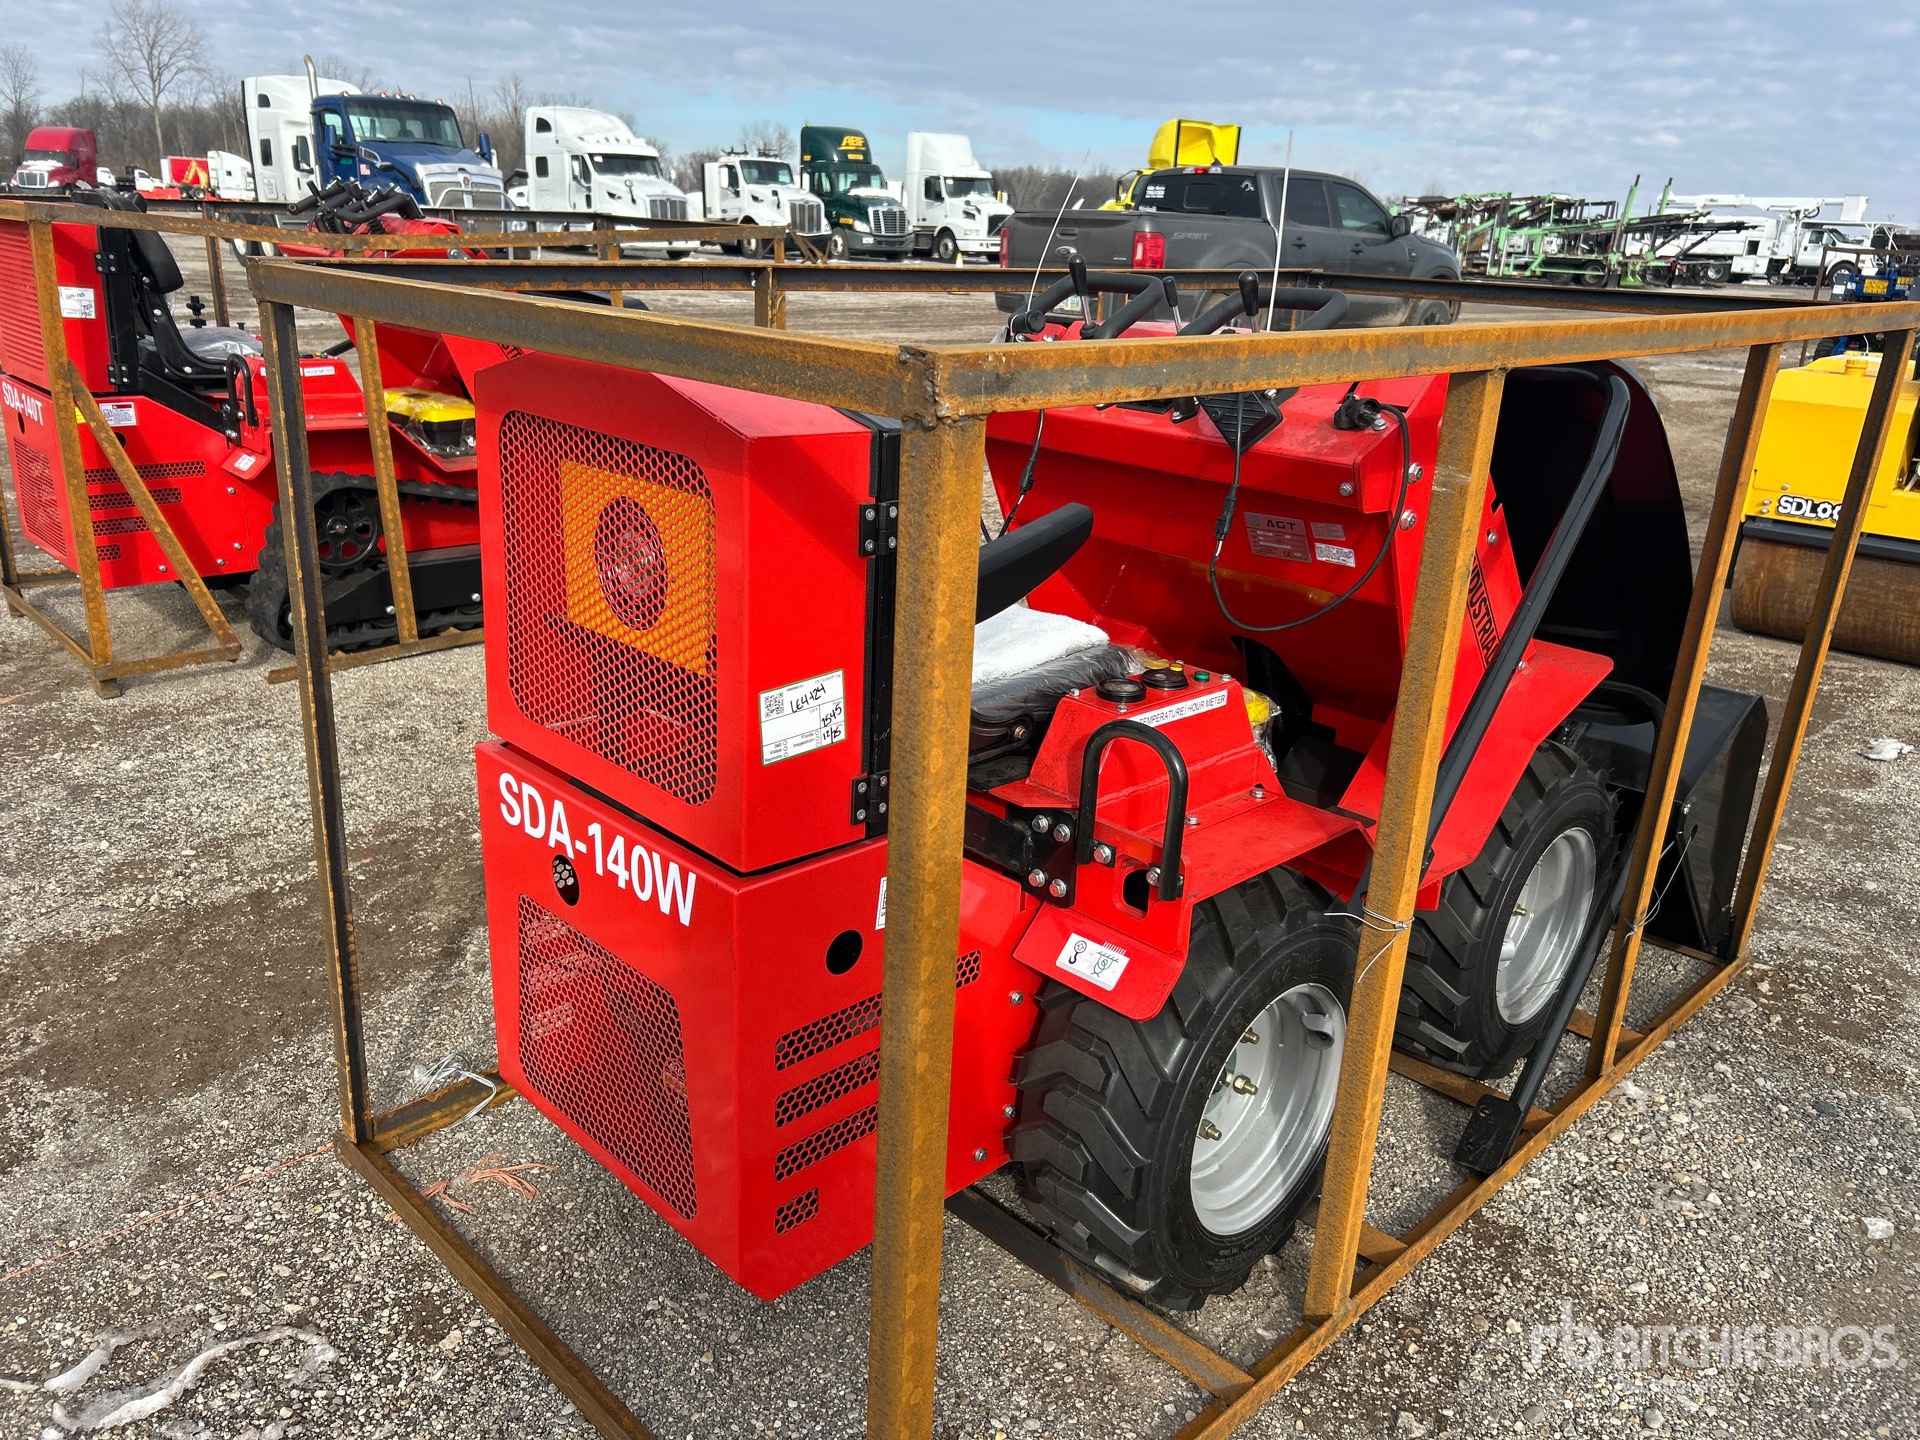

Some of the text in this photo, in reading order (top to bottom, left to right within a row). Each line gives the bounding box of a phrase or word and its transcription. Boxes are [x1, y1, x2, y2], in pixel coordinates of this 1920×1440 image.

[2, 381, 43, 426] SDA-140T
[1266, 519, 1296, 531] AGT
[1187, 694, 1226, 714] HOUR METER
[1140, 706, 1185, 724] TEMPERATURE
[499, 772, 697, 927] SDA-140W
